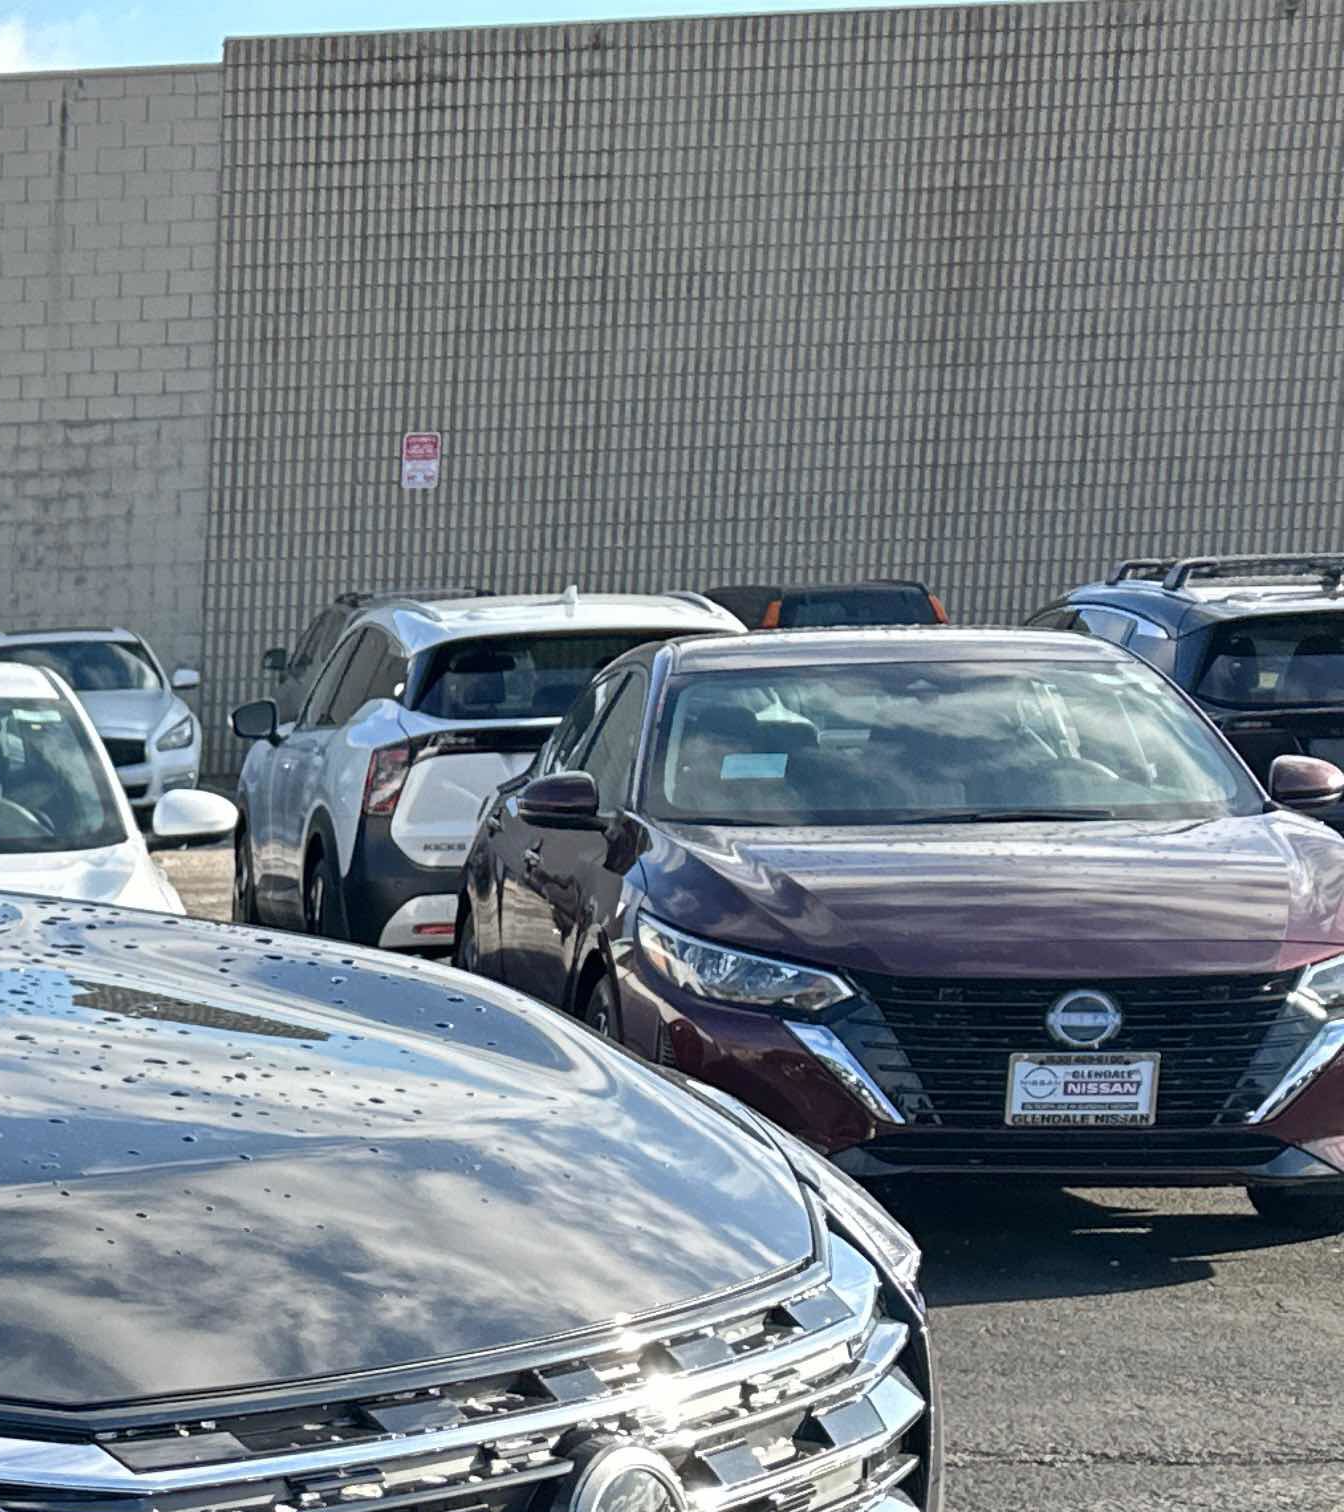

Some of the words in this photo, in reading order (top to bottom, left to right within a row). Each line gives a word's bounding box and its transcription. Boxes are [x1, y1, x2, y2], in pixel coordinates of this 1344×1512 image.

[1072, 1069, 1134, 1079] GLENDALE
[1067, 1082, 1138, 1094] NISSAN
[1012, 1113, 1090, 1125] GLENDALE
[1094, 1113, 1150, 1125] NISSAN
